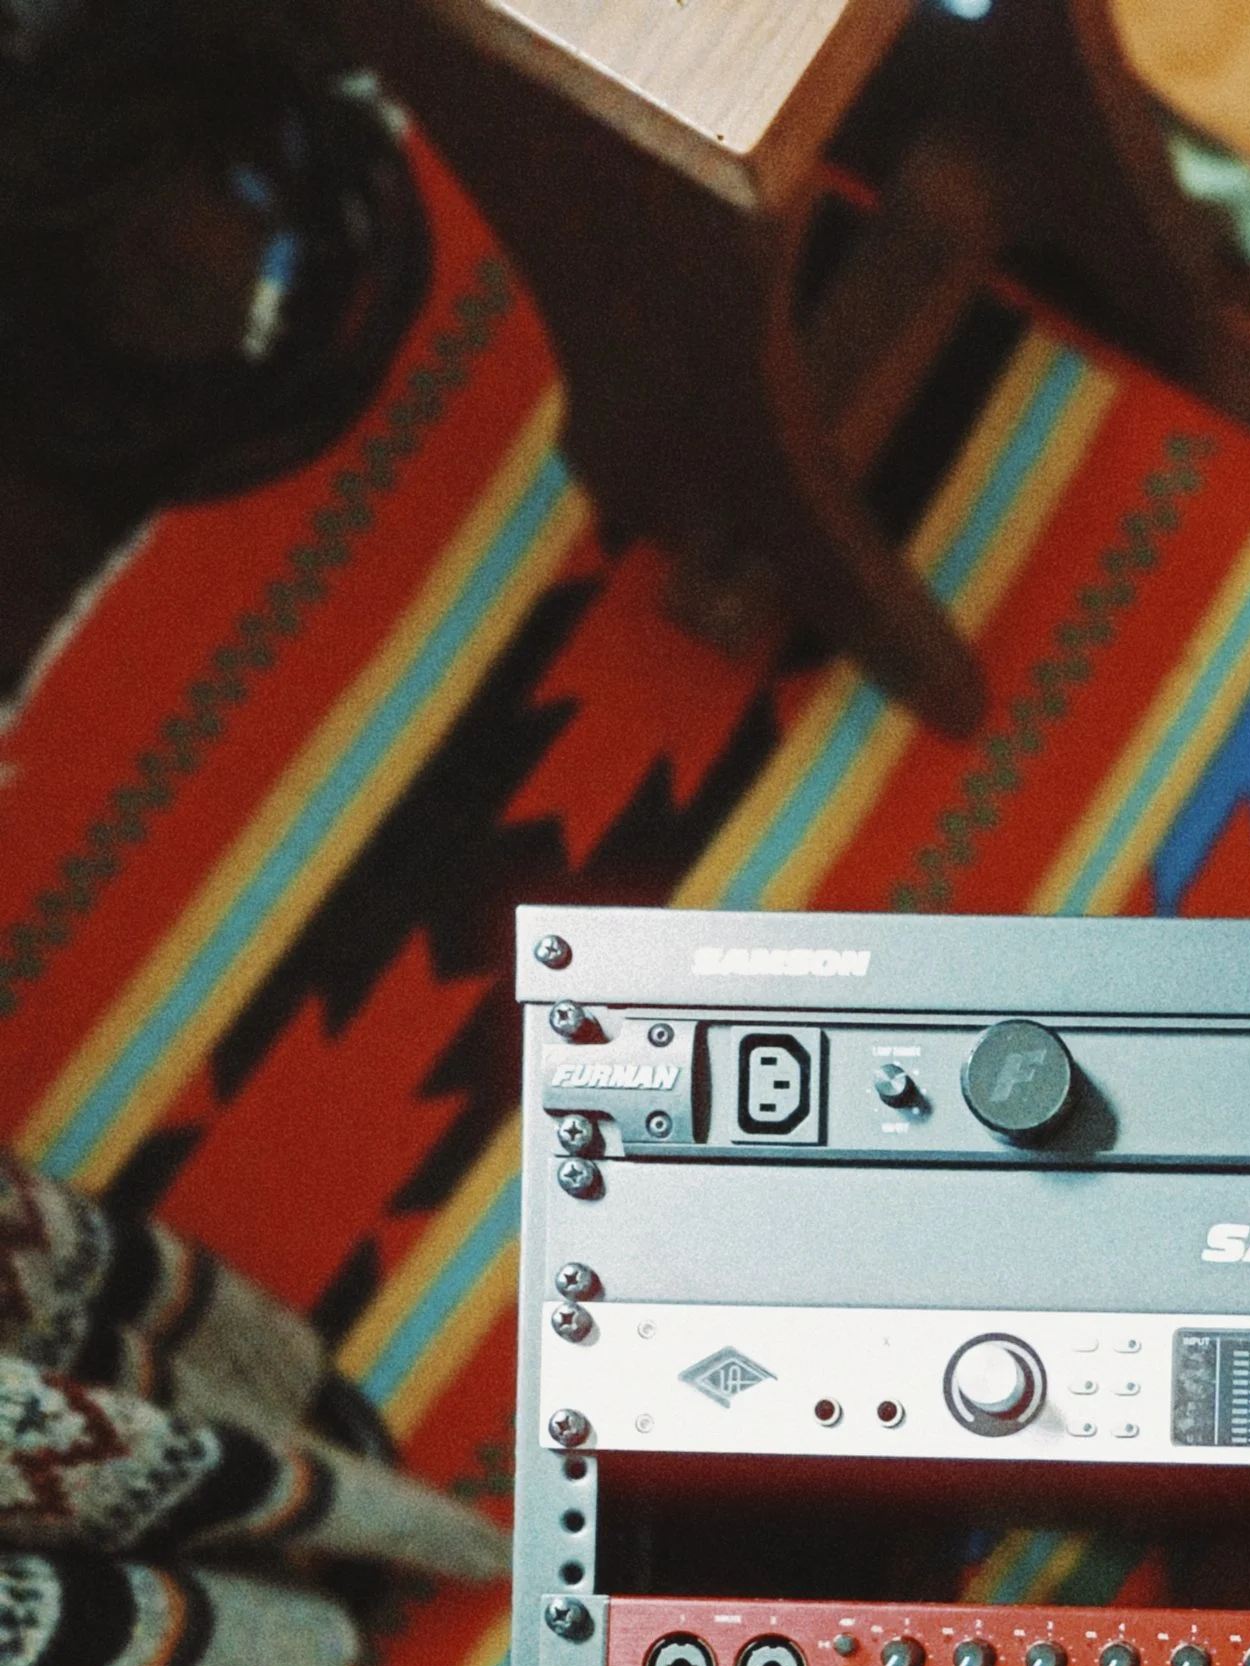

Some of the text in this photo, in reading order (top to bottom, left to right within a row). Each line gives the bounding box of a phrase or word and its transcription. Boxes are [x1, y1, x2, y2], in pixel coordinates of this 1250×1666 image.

[692, 947, 871, 976] SAMSON
[551, 1064, 682, 1090] FURMAN
[1183, 1337, 1210, 1346] INPUT
